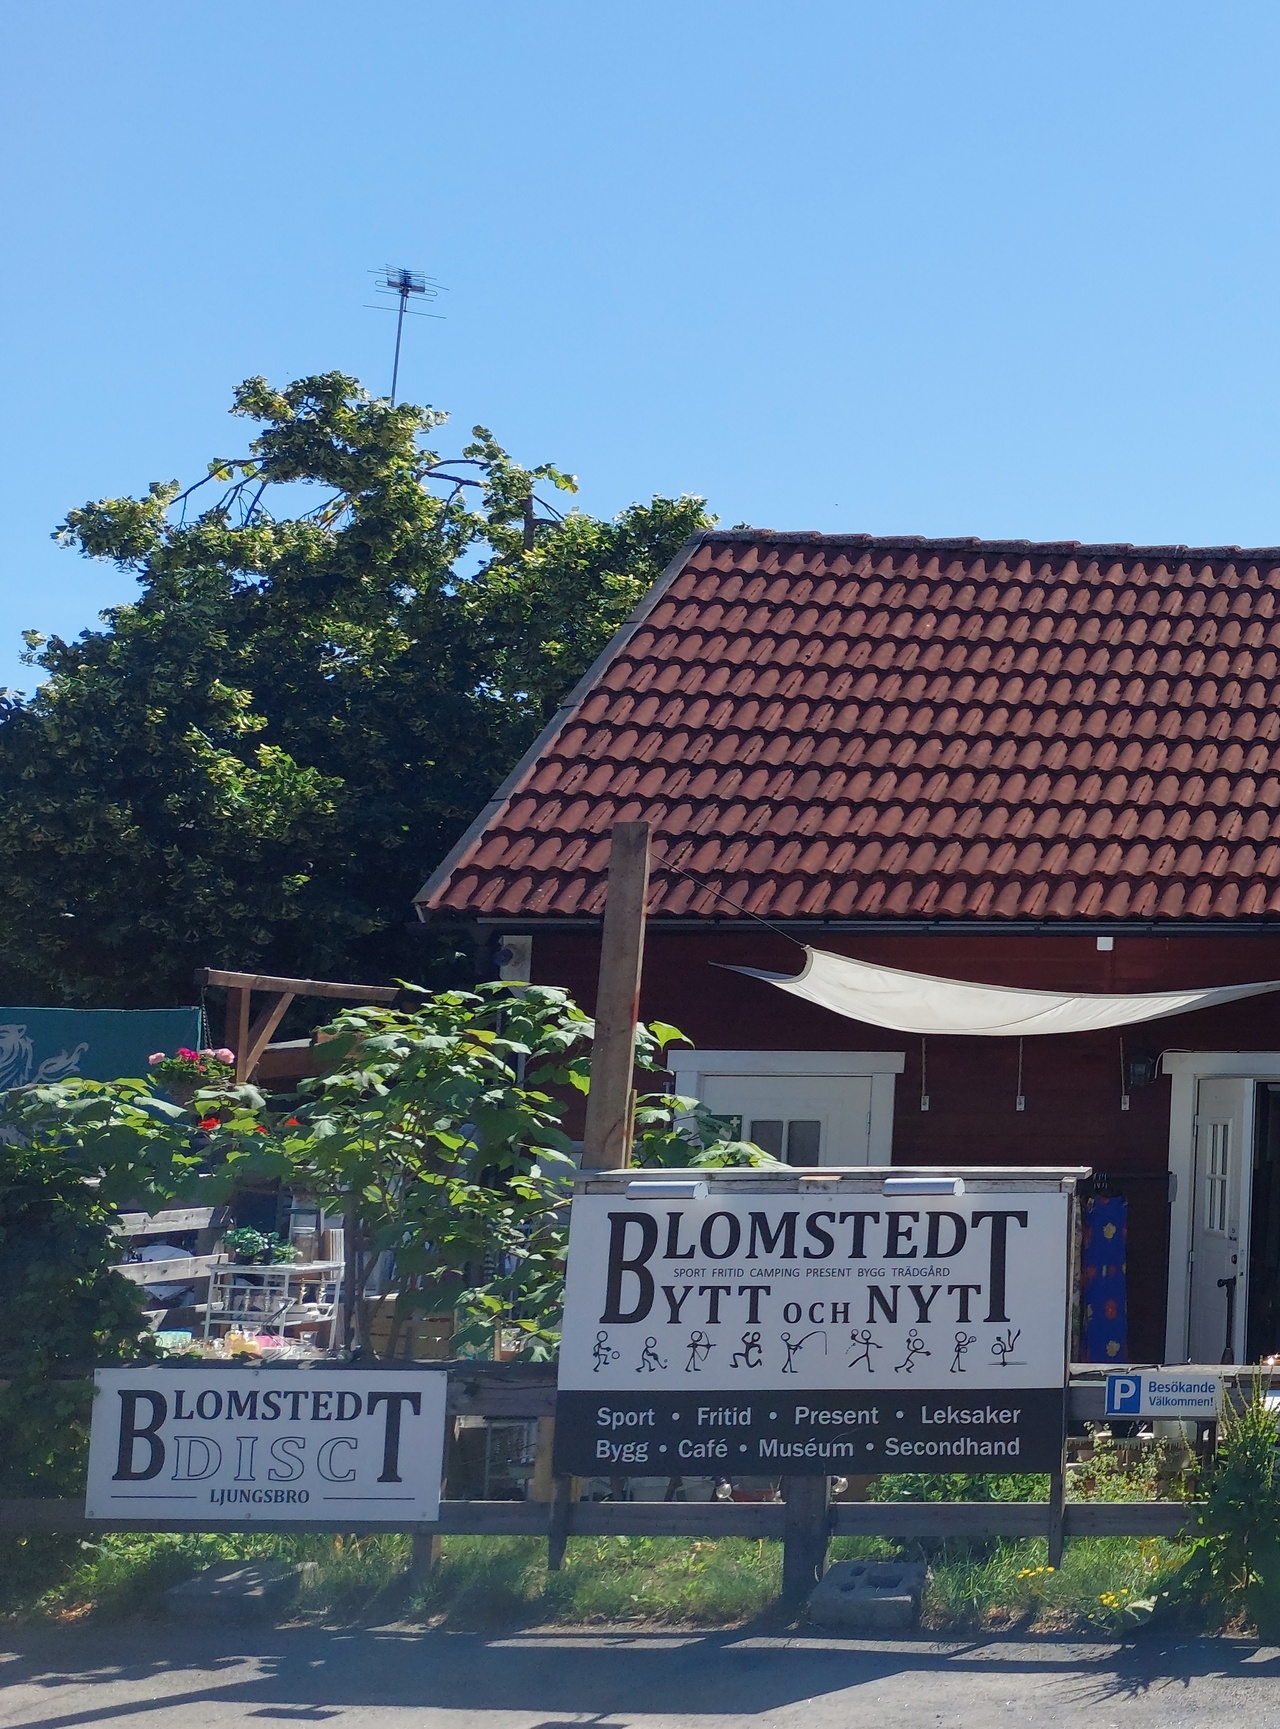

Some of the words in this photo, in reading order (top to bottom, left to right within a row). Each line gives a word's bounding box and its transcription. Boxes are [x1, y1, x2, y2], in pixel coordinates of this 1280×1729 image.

[673, 1267, 707, 1278] SPORT
[712, 1267, 744, 1278] FRITID
[750, 1267, 800, 1278] CAMPING
[806, 1267, 852, 1278] PRESENT
[857, 1267, 886, 1278] BYGG
[892, 1264, 950, 1277] TRÄDGÅRD
[783, 1302, 850, 1324] OCH
[1148, 1381, 1216, 1393] Besökande
[1149, 1396, 1214, 1407] Välkommen!
[596, 1407, 656, 1430] Sport
[697, 1406, 751, 1426] Fritid
[794, 1405, 880, 1425] Present
[921, 1405, 1022, 1424] Leksaker
[171, 1435, 358, 1482] DISC
[596, 1439, 650, 1462] Bygg
[678, 1438, 728, 1458] Café
[759, 1438, 854, 1458] Muséum
[885, 1437, 1020, 1456] Secondhand
[209, 1488, 310, 1506] LJUNGSBRO
